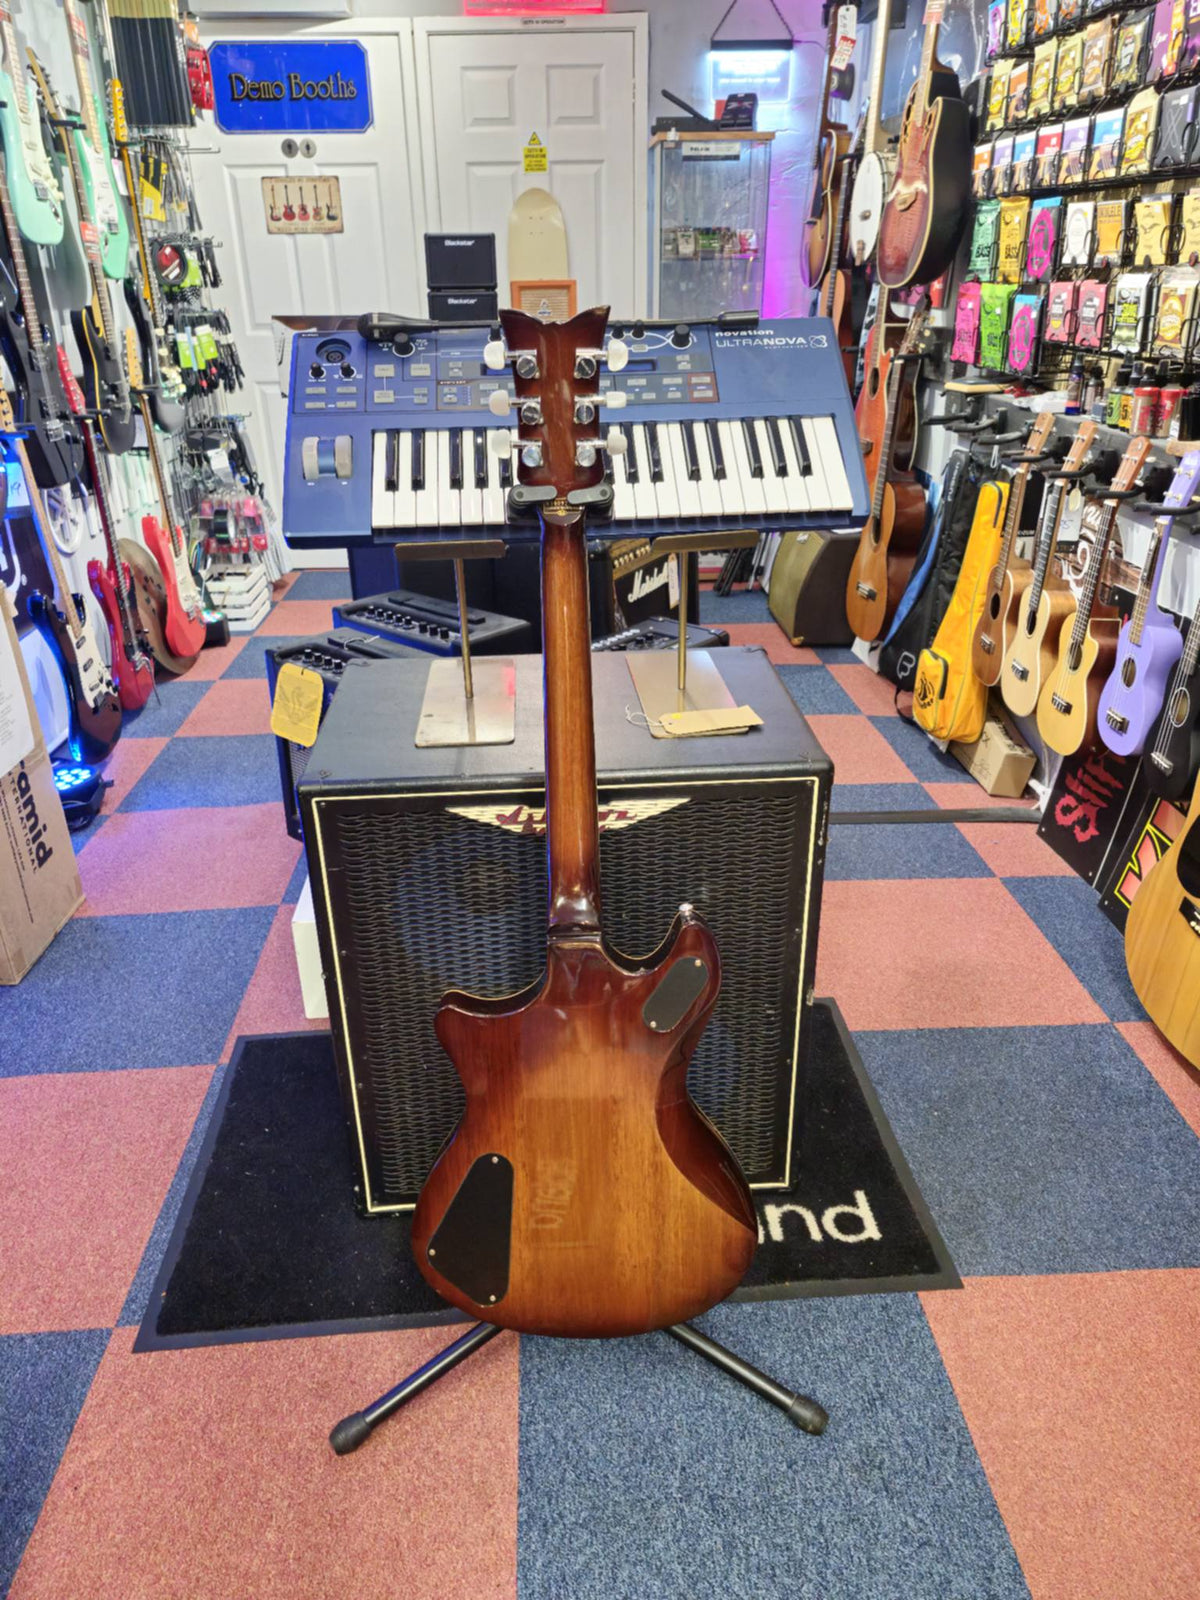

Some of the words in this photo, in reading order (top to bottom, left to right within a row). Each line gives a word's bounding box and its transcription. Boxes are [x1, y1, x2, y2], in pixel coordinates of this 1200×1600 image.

[229, 73, 285, 101] Demo
[288, 71, 357, 100] Booths
[444, 239, 475, 247] Blackstar
[715, 329, 774, 337] novation
[715, 337, 807, 348] ULTRANOVA
[627, 561, 668, 604] Marshal
